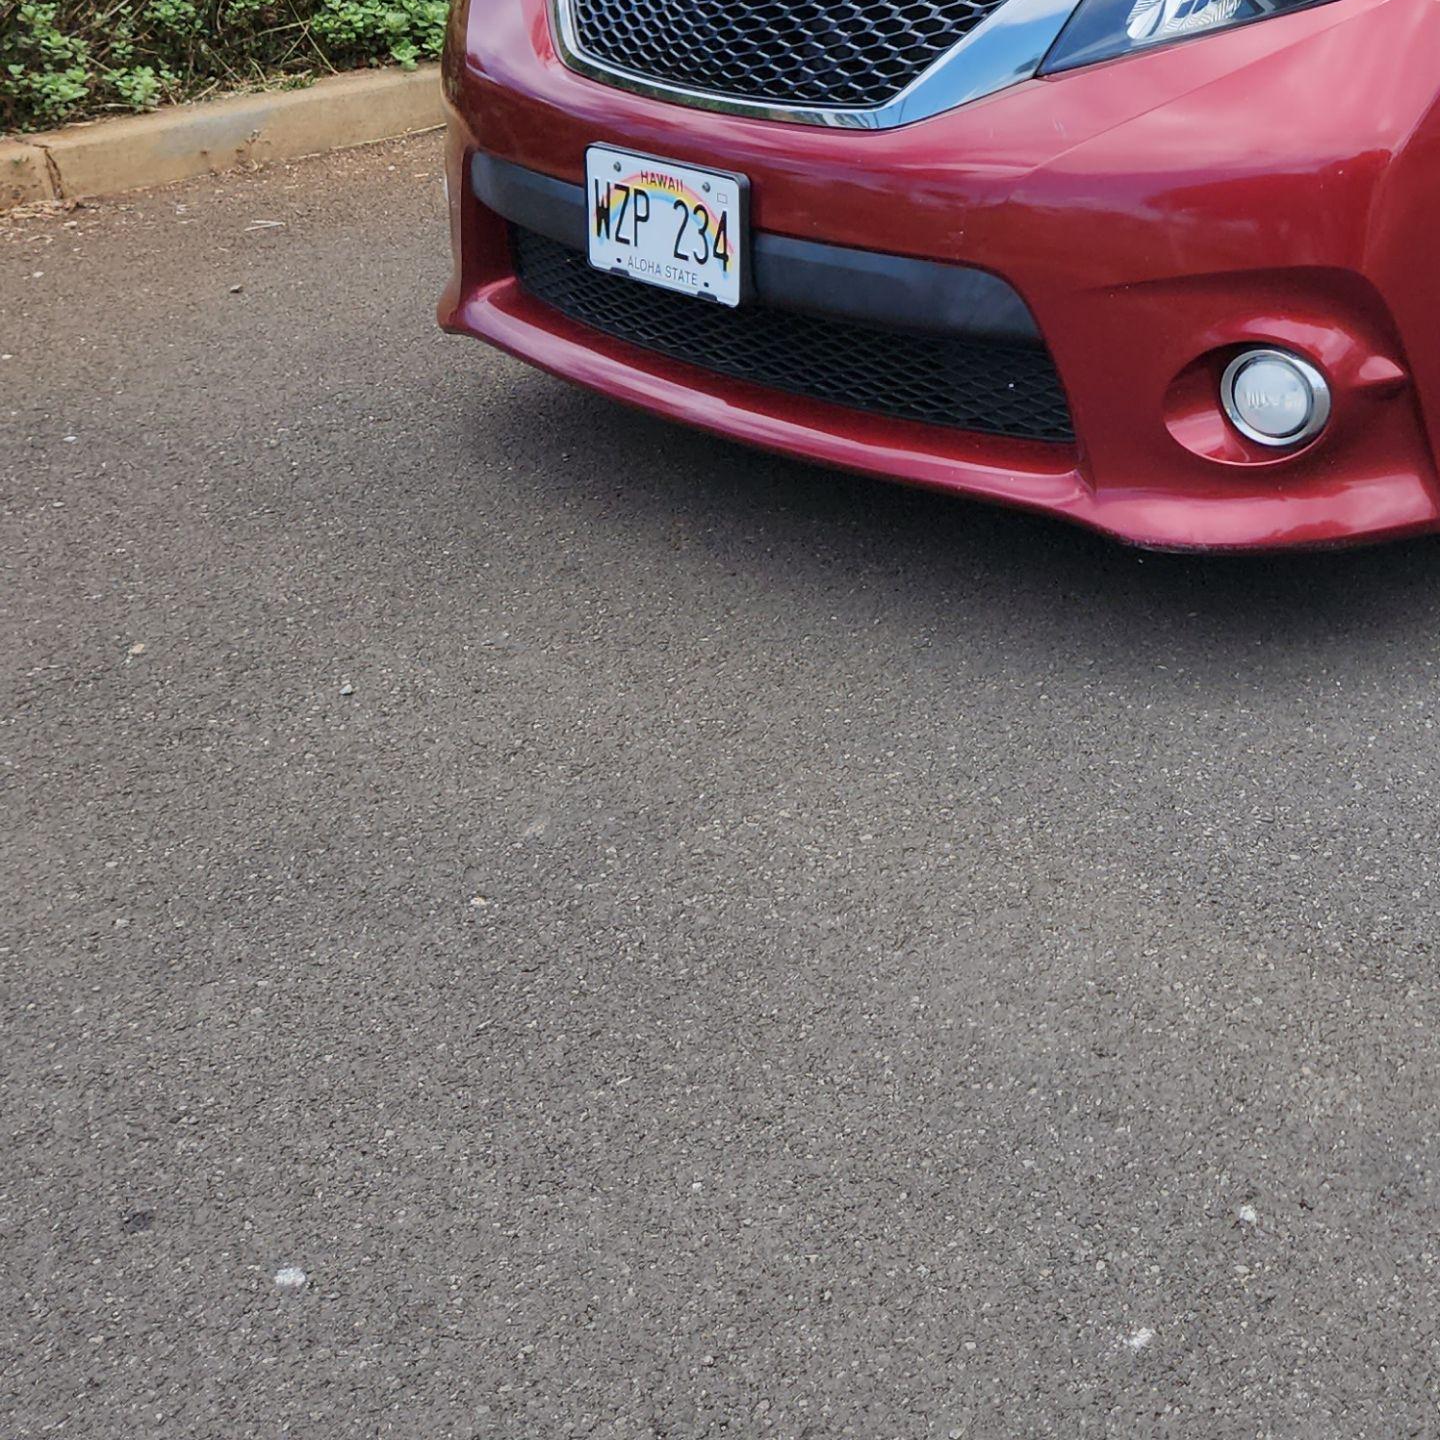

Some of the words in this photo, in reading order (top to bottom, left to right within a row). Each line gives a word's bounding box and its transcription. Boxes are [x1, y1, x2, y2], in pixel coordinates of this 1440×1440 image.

[641, 170, 684, 193] HAWAII
[594, 178, 650, 248] WZP
[673, 199, 730, 273] 234
[627, 256, 662, 276] ALOHA
[665, 265, 699, 287] STATE
